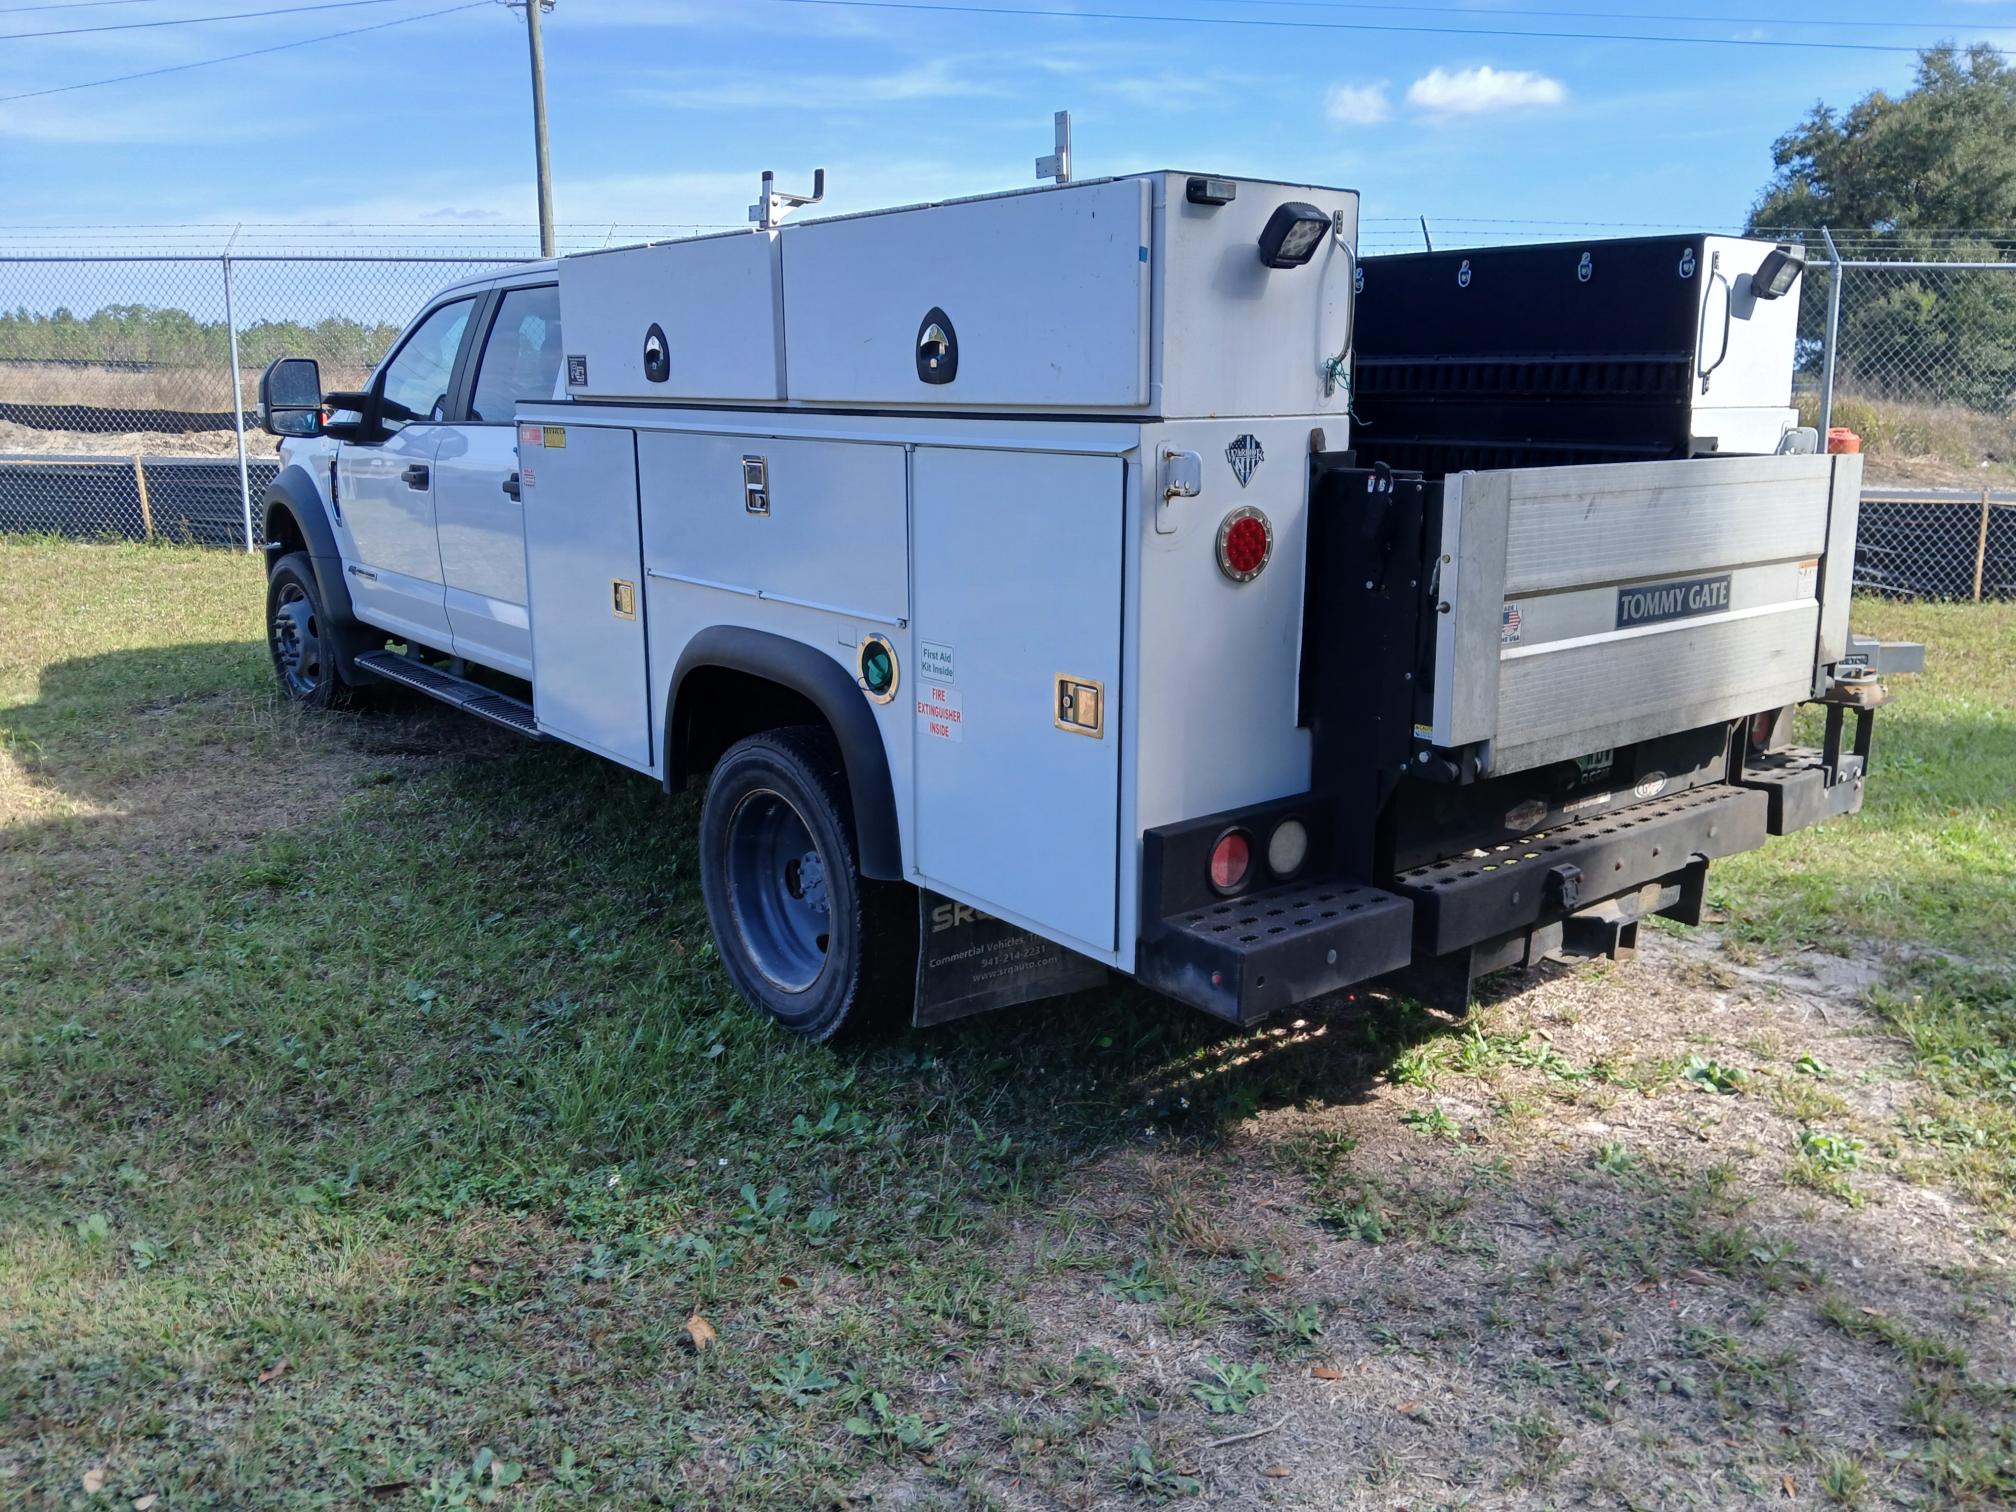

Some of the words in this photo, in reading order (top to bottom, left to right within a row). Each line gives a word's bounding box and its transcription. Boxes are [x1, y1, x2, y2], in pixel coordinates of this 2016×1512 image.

[1620, 587, 1686, 620] TOMMY
[1688, 581, 1728, 609] GATE
[923, 648, 939, 660] First
[939, 652, 952, 663] Aid
[921, 661, 932, 673] Kit
[932, 663, 953, 677] Inside
[932, 687, 946, 702] FIRE
[917, 702, 961, 723] EXTINGUISHER
[929, 721, 950, 738] INSIDE
[929, 945, 985, 968] Commercial
[981, 944, 1047, 968] 941-214-2231
[972, 956, 1058, 983] www.srqauto.com
